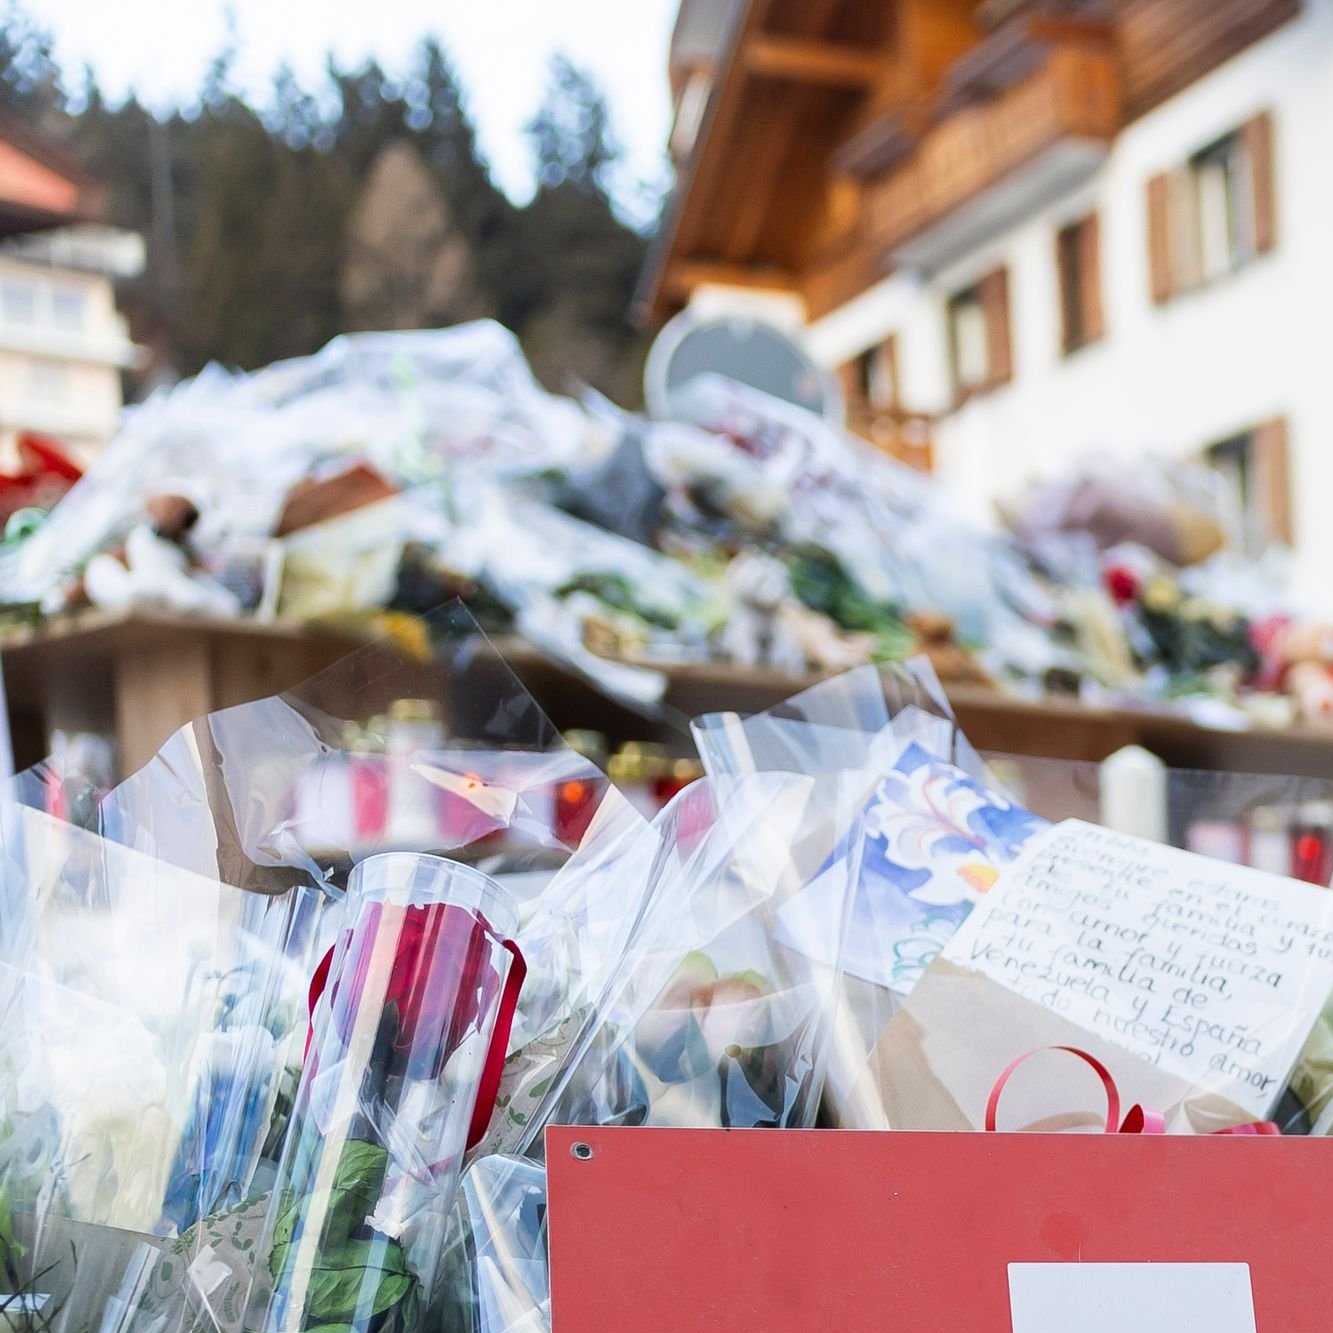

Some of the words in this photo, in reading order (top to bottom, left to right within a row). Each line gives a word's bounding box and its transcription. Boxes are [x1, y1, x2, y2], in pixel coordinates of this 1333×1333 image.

[981, 907, 1051, 935] para
[1076, 929, 1104, 951] la
[1069, 910, 1149, 944] amor
[1165, 940, 1183, 962] y
[1270, 932, 1297, 954] y
[1001, 931, 1034, 952] tu
[1047, 944, 1158, 993] familia
[1171, 986, 1209, 1009] de
[970, 937, 1111, 1003] Venezuela
[1159, 1003, 1264, 1055] España
[1093, 1007, 1195, 1058] nuestro
